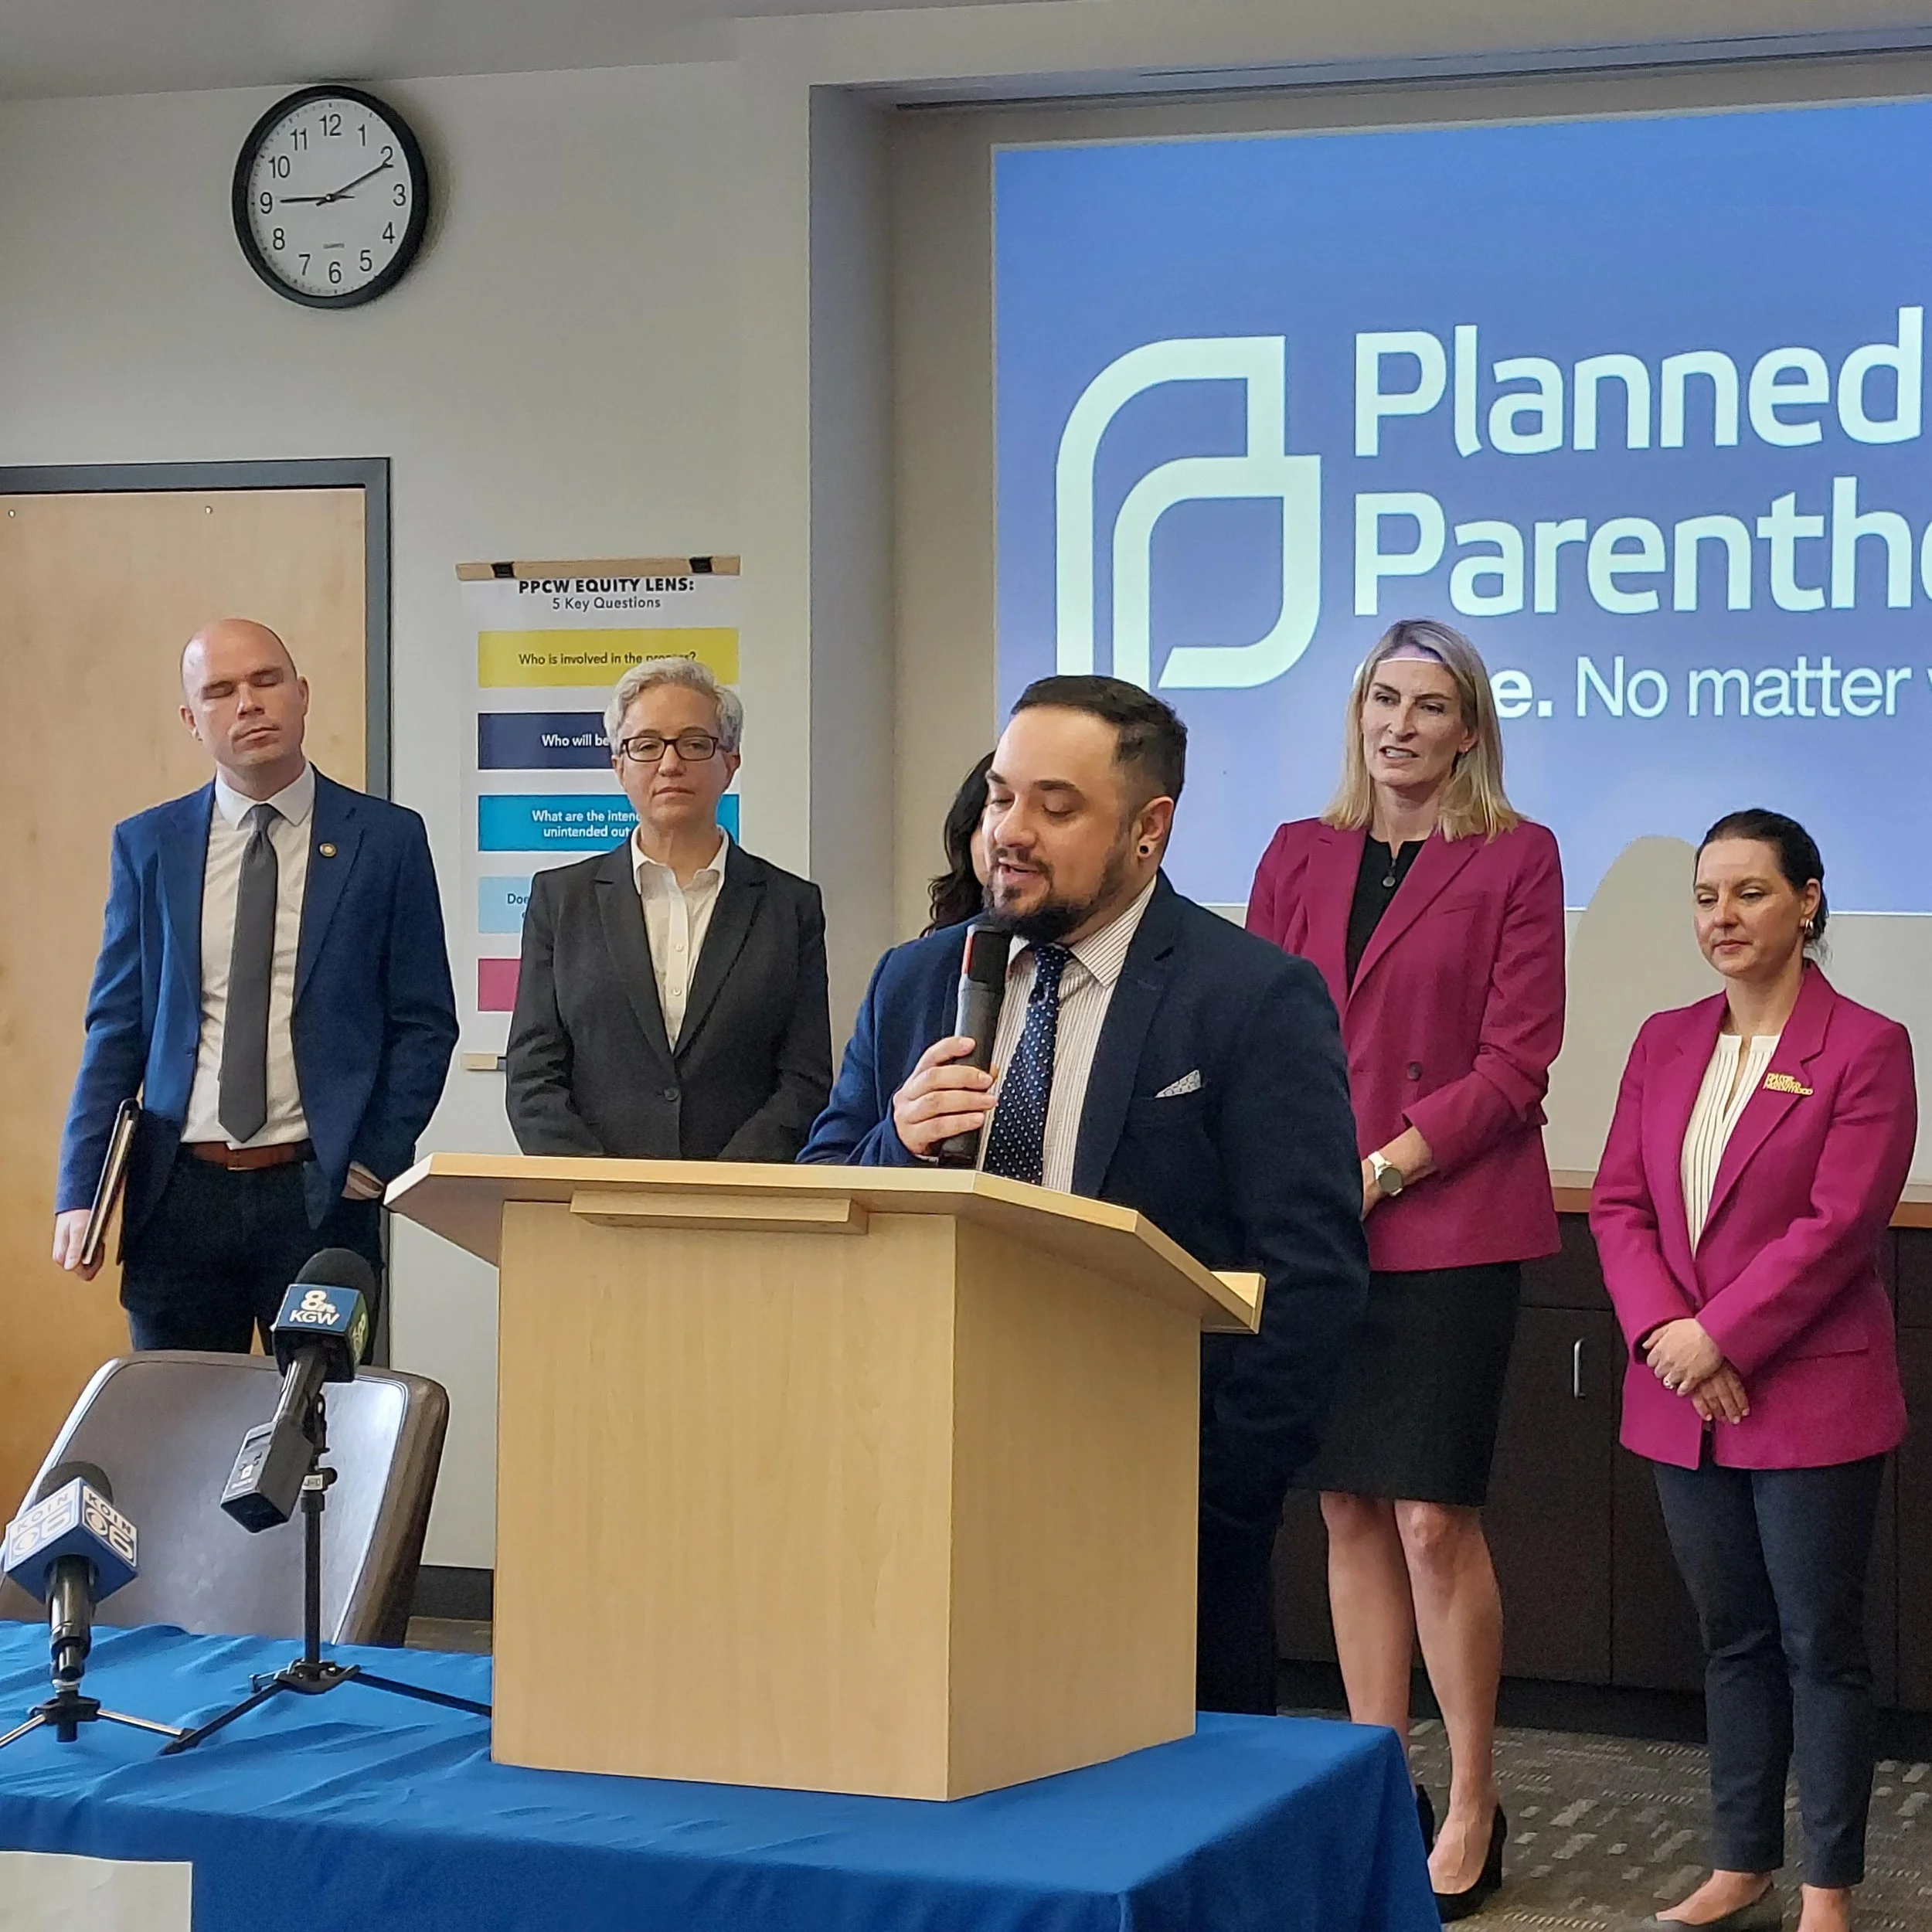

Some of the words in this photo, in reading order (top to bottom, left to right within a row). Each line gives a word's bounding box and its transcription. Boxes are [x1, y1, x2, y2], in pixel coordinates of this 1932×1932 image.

[319, 114, 342, 136] 12
[358, 124, 366, 146] 1
[290, 128, 308, 151] 11
[268, 155, 290, 179] 10
[380, 146, 393, 168] 2
[260, 192, 273, 214] 9
[393, 184, 406, 206] 3
[273, 228, 285, 250] 8
[383, 222, 395, 243] 4
[298, 253, 311, 275] 7
[359, 250, 372, 271] 5
[328, 261, 342, 284] 6
[1355, 305, 1923, 457] Planned
[1355, 475, 1932, 617] Parenth
[519, 580, 570, 594] PPCW
[576, 578, 641, 593] EQUITY
[645, 577, 694, 592] LENS:
[553, 597, 560, 610] 5
[565, 597, 590, 612] Key
[594, 596, 661, 609] Questions
[519, 654, 546, 665] Who
[549, 654, 558, 665] is
[560, 652, 607, 665] involved
[611, 652, 621, 664] in
[624, 652, 643, 664] the
[1577, 655, 1668, 718] No
[1689, 655, 1912, 718] matter
[541, 734, 570, 747] Who
[572, 734, 592, 746] will
[532, 810, 562, 822] What
[565, 811, 583, 821] are
[587, 810, 604, 821] the
[543, 825, 608, 837] unintended
[301, 1290, 327, 1311] 8
[289, 1310, 340, 1325] KGW
[17, 1493, 69, 1532] KOIN
[88, 1492, 131, 1535] KOIN
